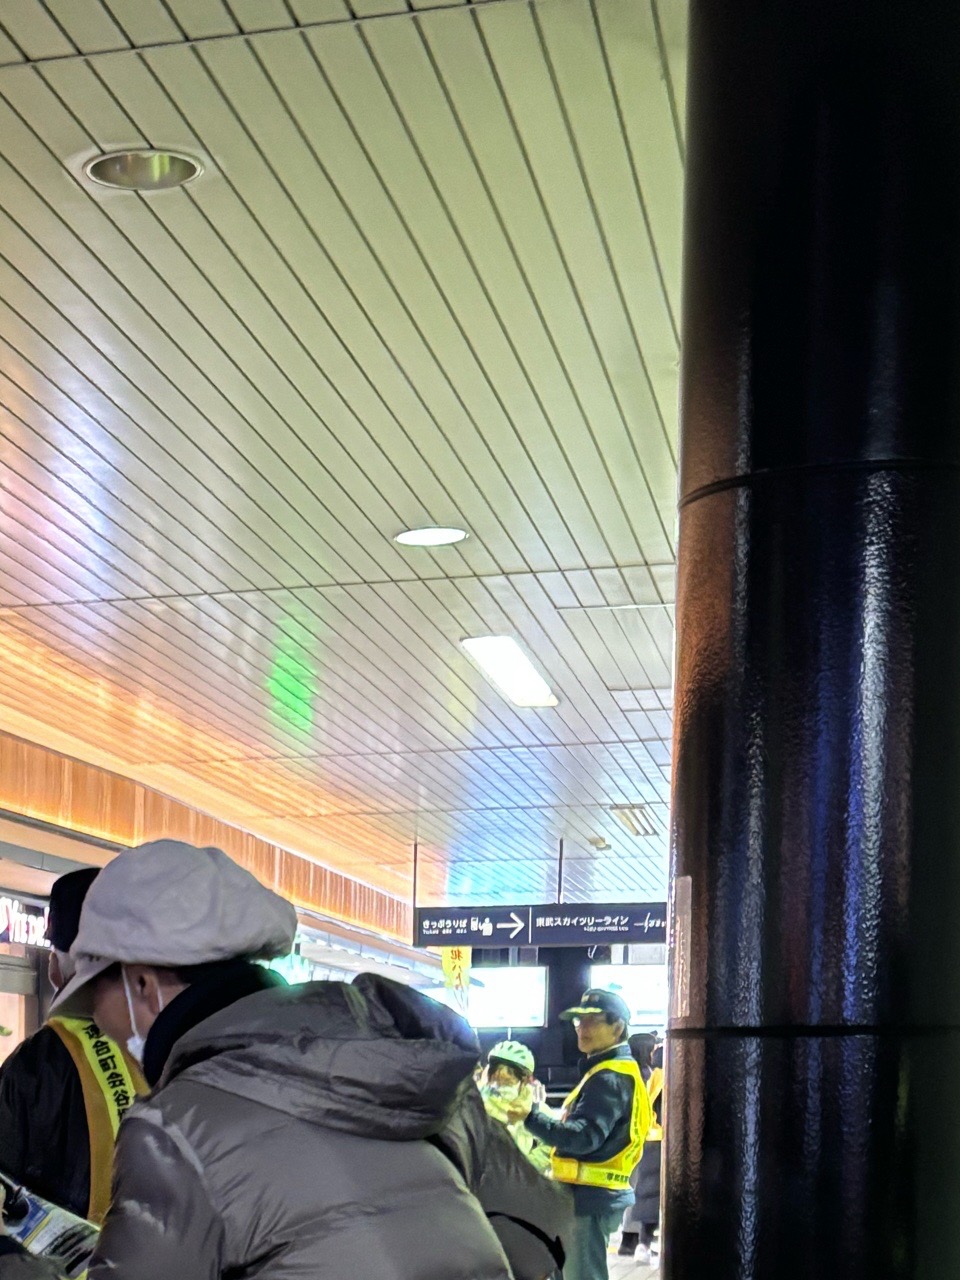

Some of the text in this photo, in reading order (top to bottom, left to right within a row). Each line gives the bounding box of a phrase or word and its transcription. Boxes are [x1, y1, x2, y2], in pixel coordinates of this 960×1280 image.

[422, 919, 468, 929] きっぷうりば
[536, 916, 629, 928] 東武スカイツリーライン
